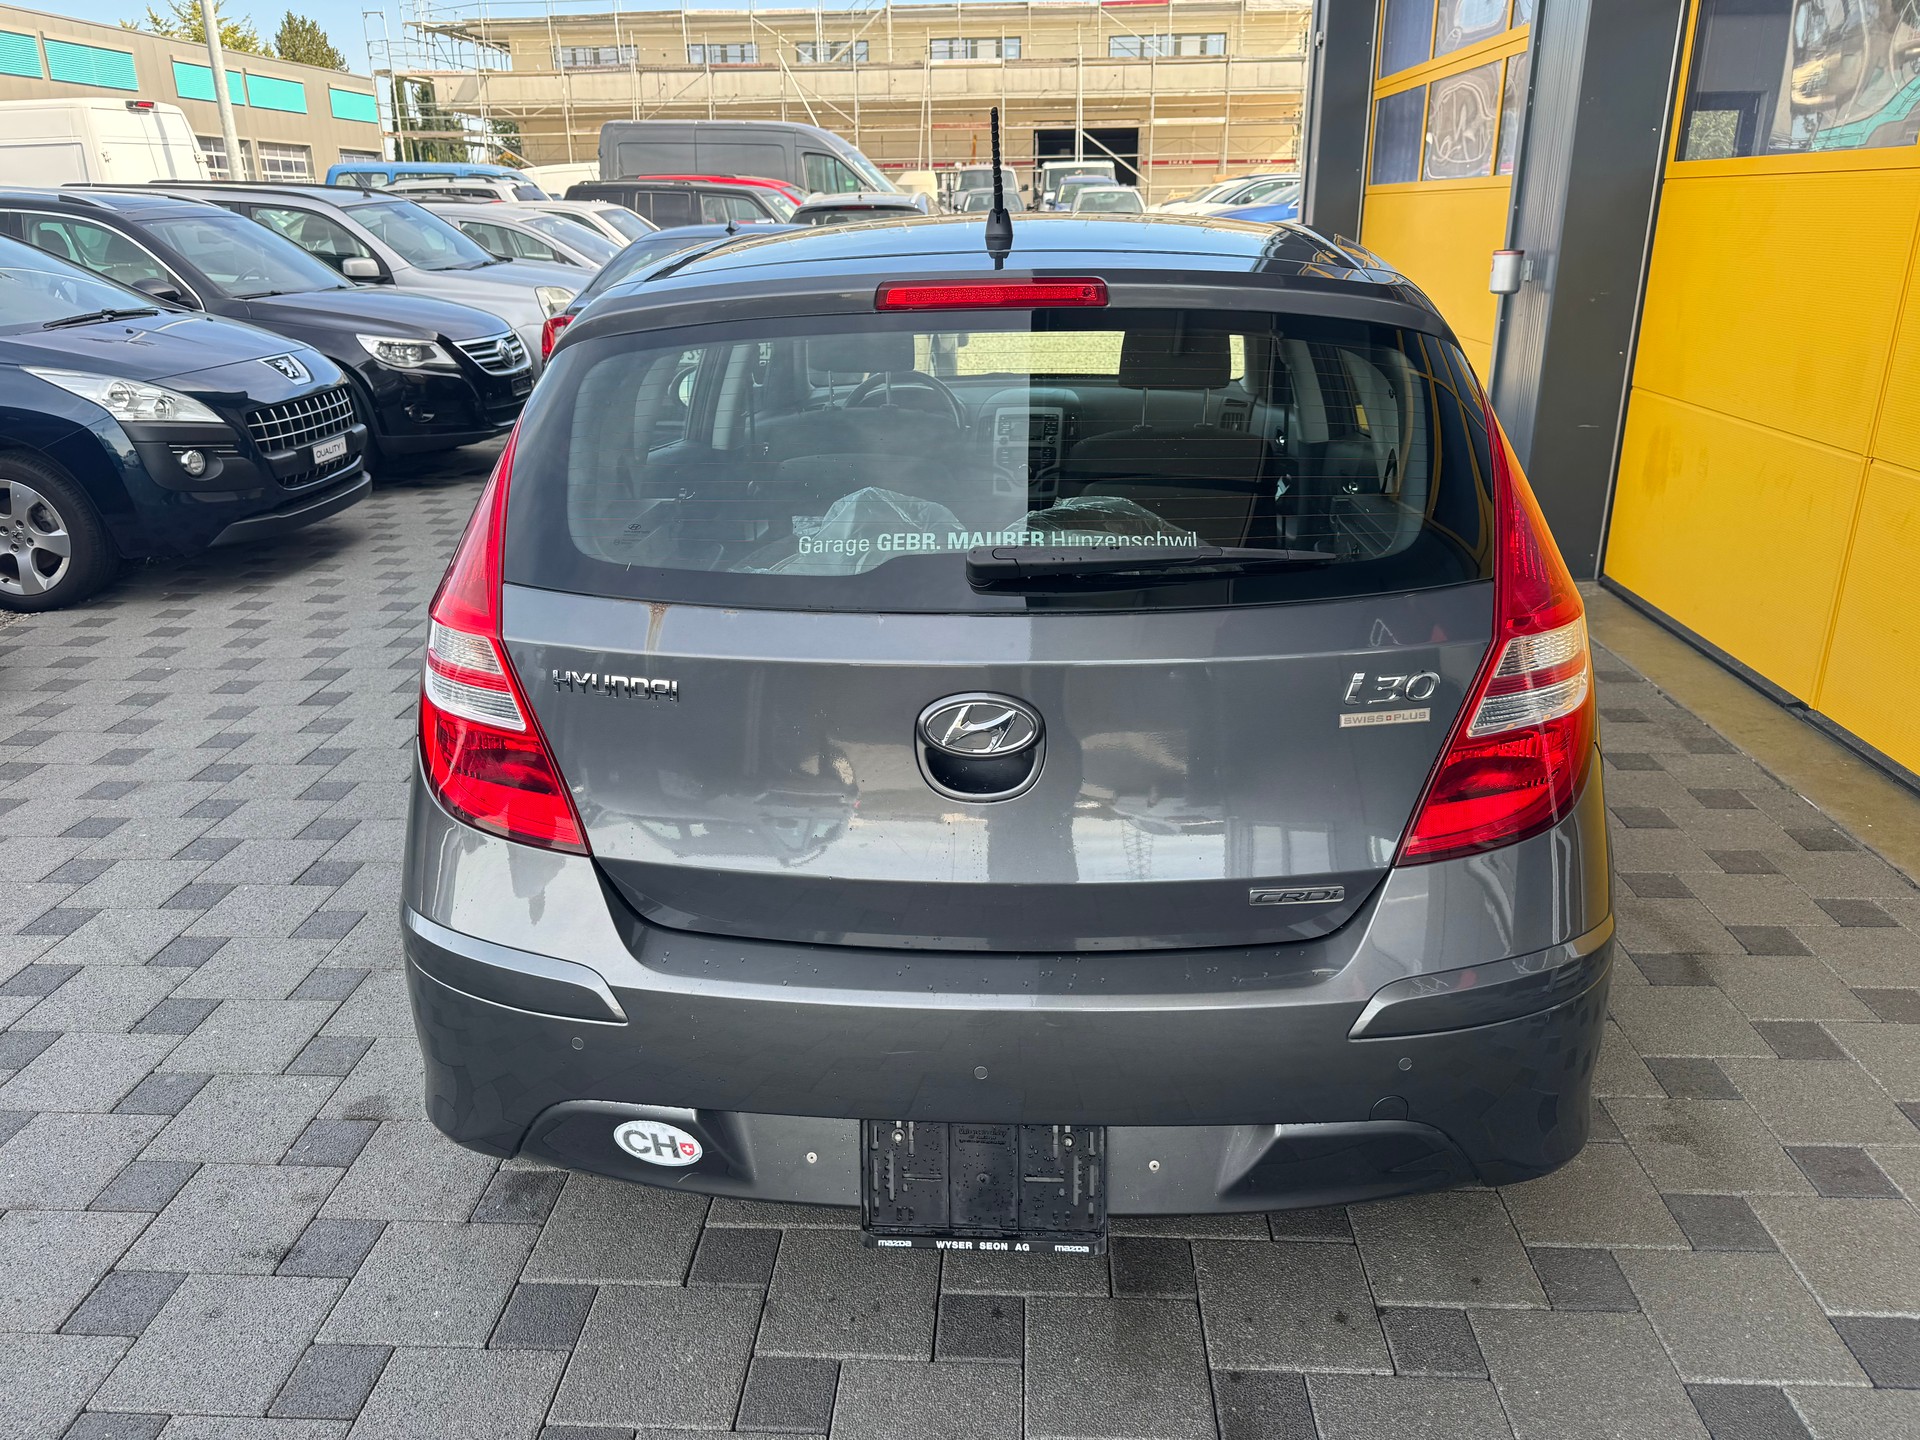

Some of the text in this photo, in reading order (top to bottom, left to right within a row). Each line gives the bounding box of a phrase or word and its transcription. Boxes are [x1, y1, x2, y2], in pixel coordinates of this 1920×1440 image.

[798, 530, 1198, 556] Garage GEBR. MAURER Hunzenschwil
[552, 669, 680, 702] HYUNDAI
[1343, 711, 1427, 725] SWISS PLUS
[623, 1130, 681, 1158] CH
[877, 1239, 1090, 1253] mazda WYSER SEON AG mazda
